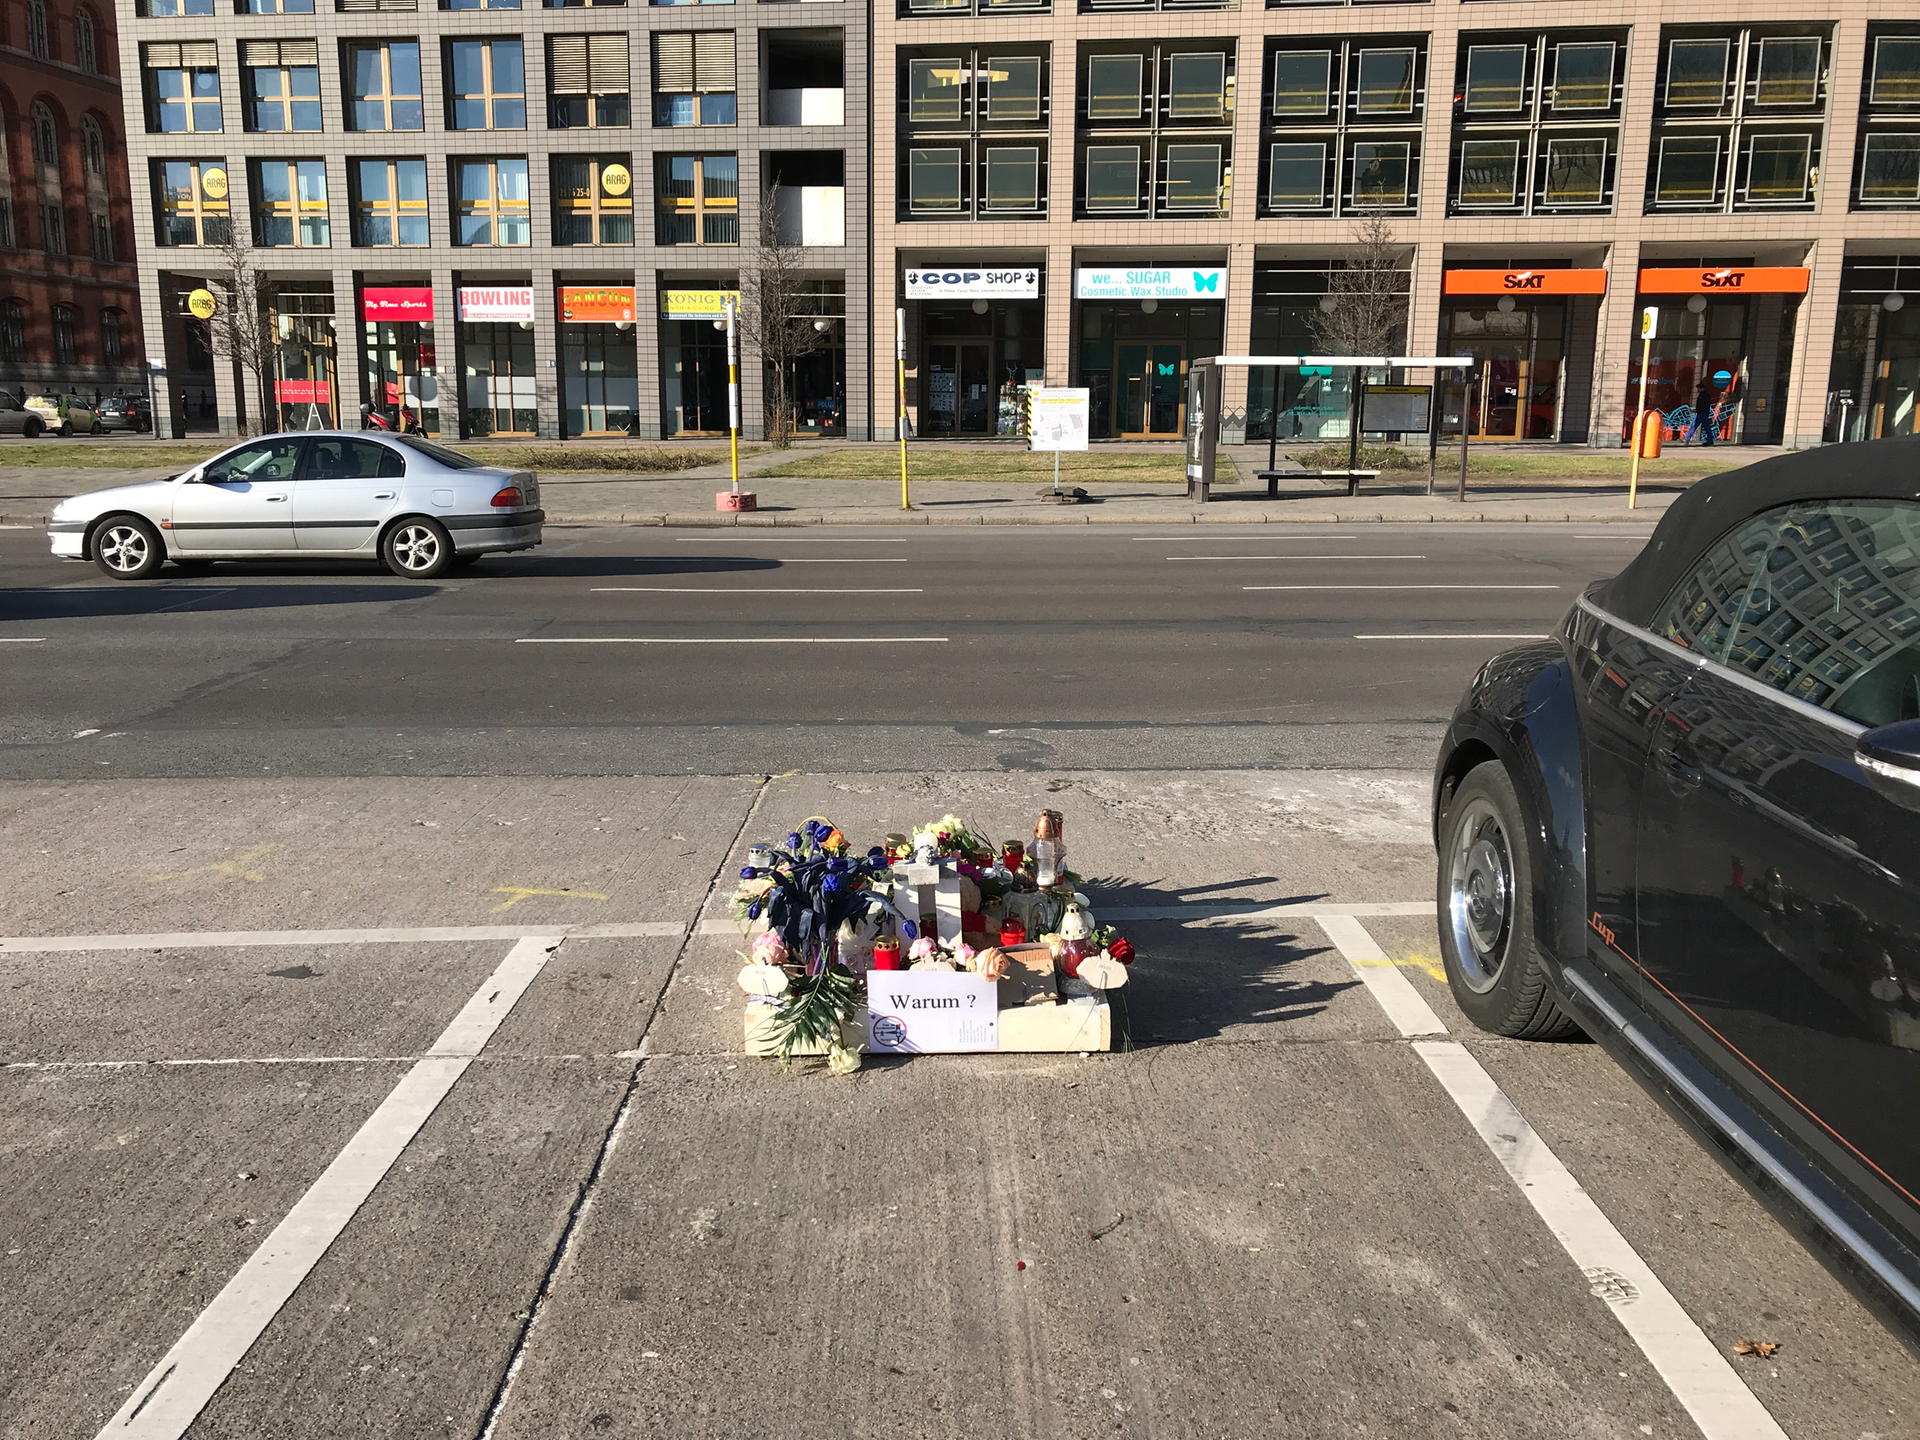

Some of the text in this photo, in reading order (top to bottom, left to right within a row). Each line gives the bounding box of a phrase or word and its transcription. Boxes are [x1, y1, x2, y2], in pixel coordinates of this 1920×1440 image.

[206, 178, 226, 188] ARAG
[606, 174, 627, 185] ARAG
[922, 272, 1022, 285] COP SHOP
[1126, 271, 1171, 284] SUGAR
[462, 291, 531, 305] BOWLING
[1588, 911, 1616, 946] Cup
[890, 994, 977, 1009] Warum ?
